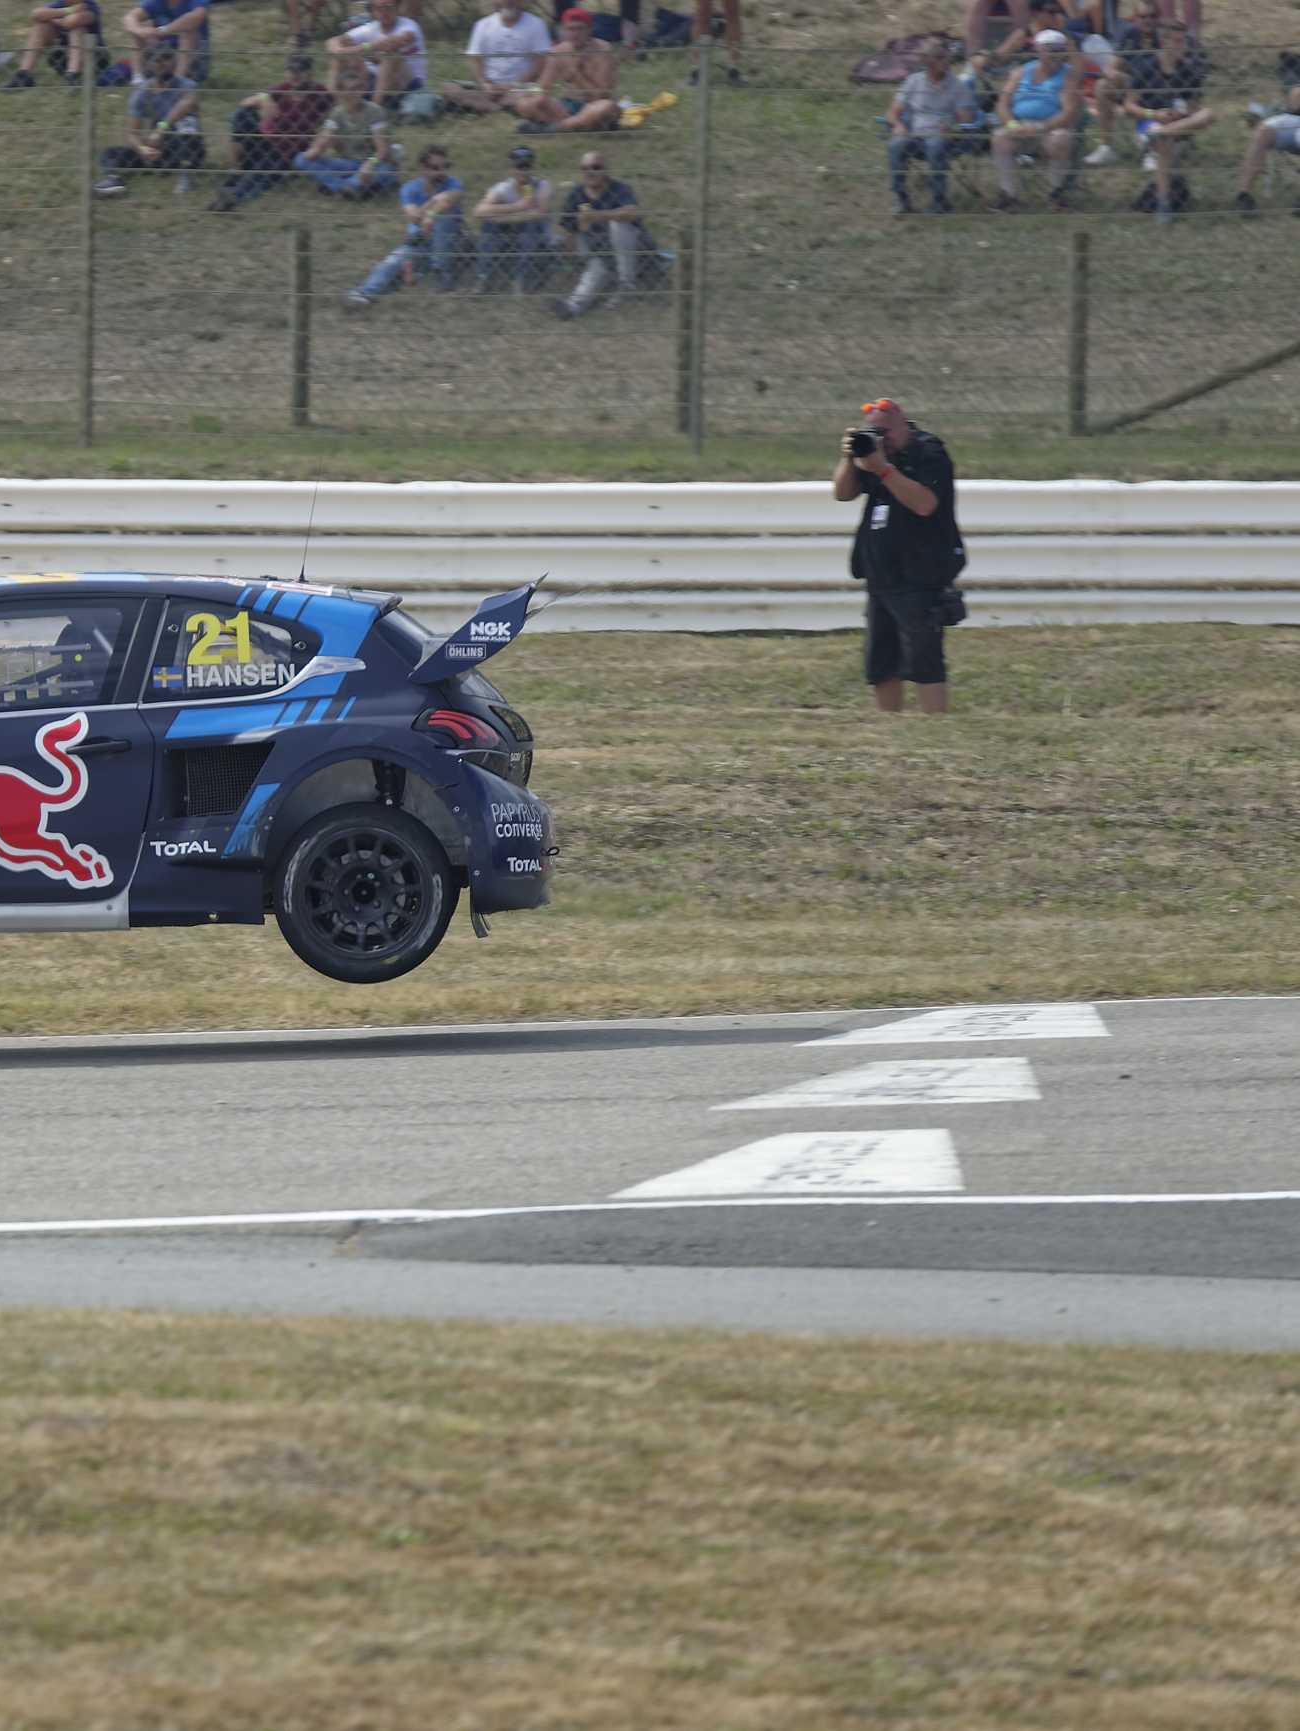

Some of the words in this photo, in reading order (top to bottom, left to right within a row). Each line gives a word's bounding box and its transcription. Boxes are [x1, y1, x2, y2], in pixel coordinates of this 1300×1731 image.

[186, 611, 251, 664] 21
[470, 622, 511, 636] NGK
[187, 663, 296, 687] HANSEN
[491, 803, 541, 823] PAPYRUS
[149, 840, 217, 857] TOTAL
[507, 857, 542, 872] TOTAL
